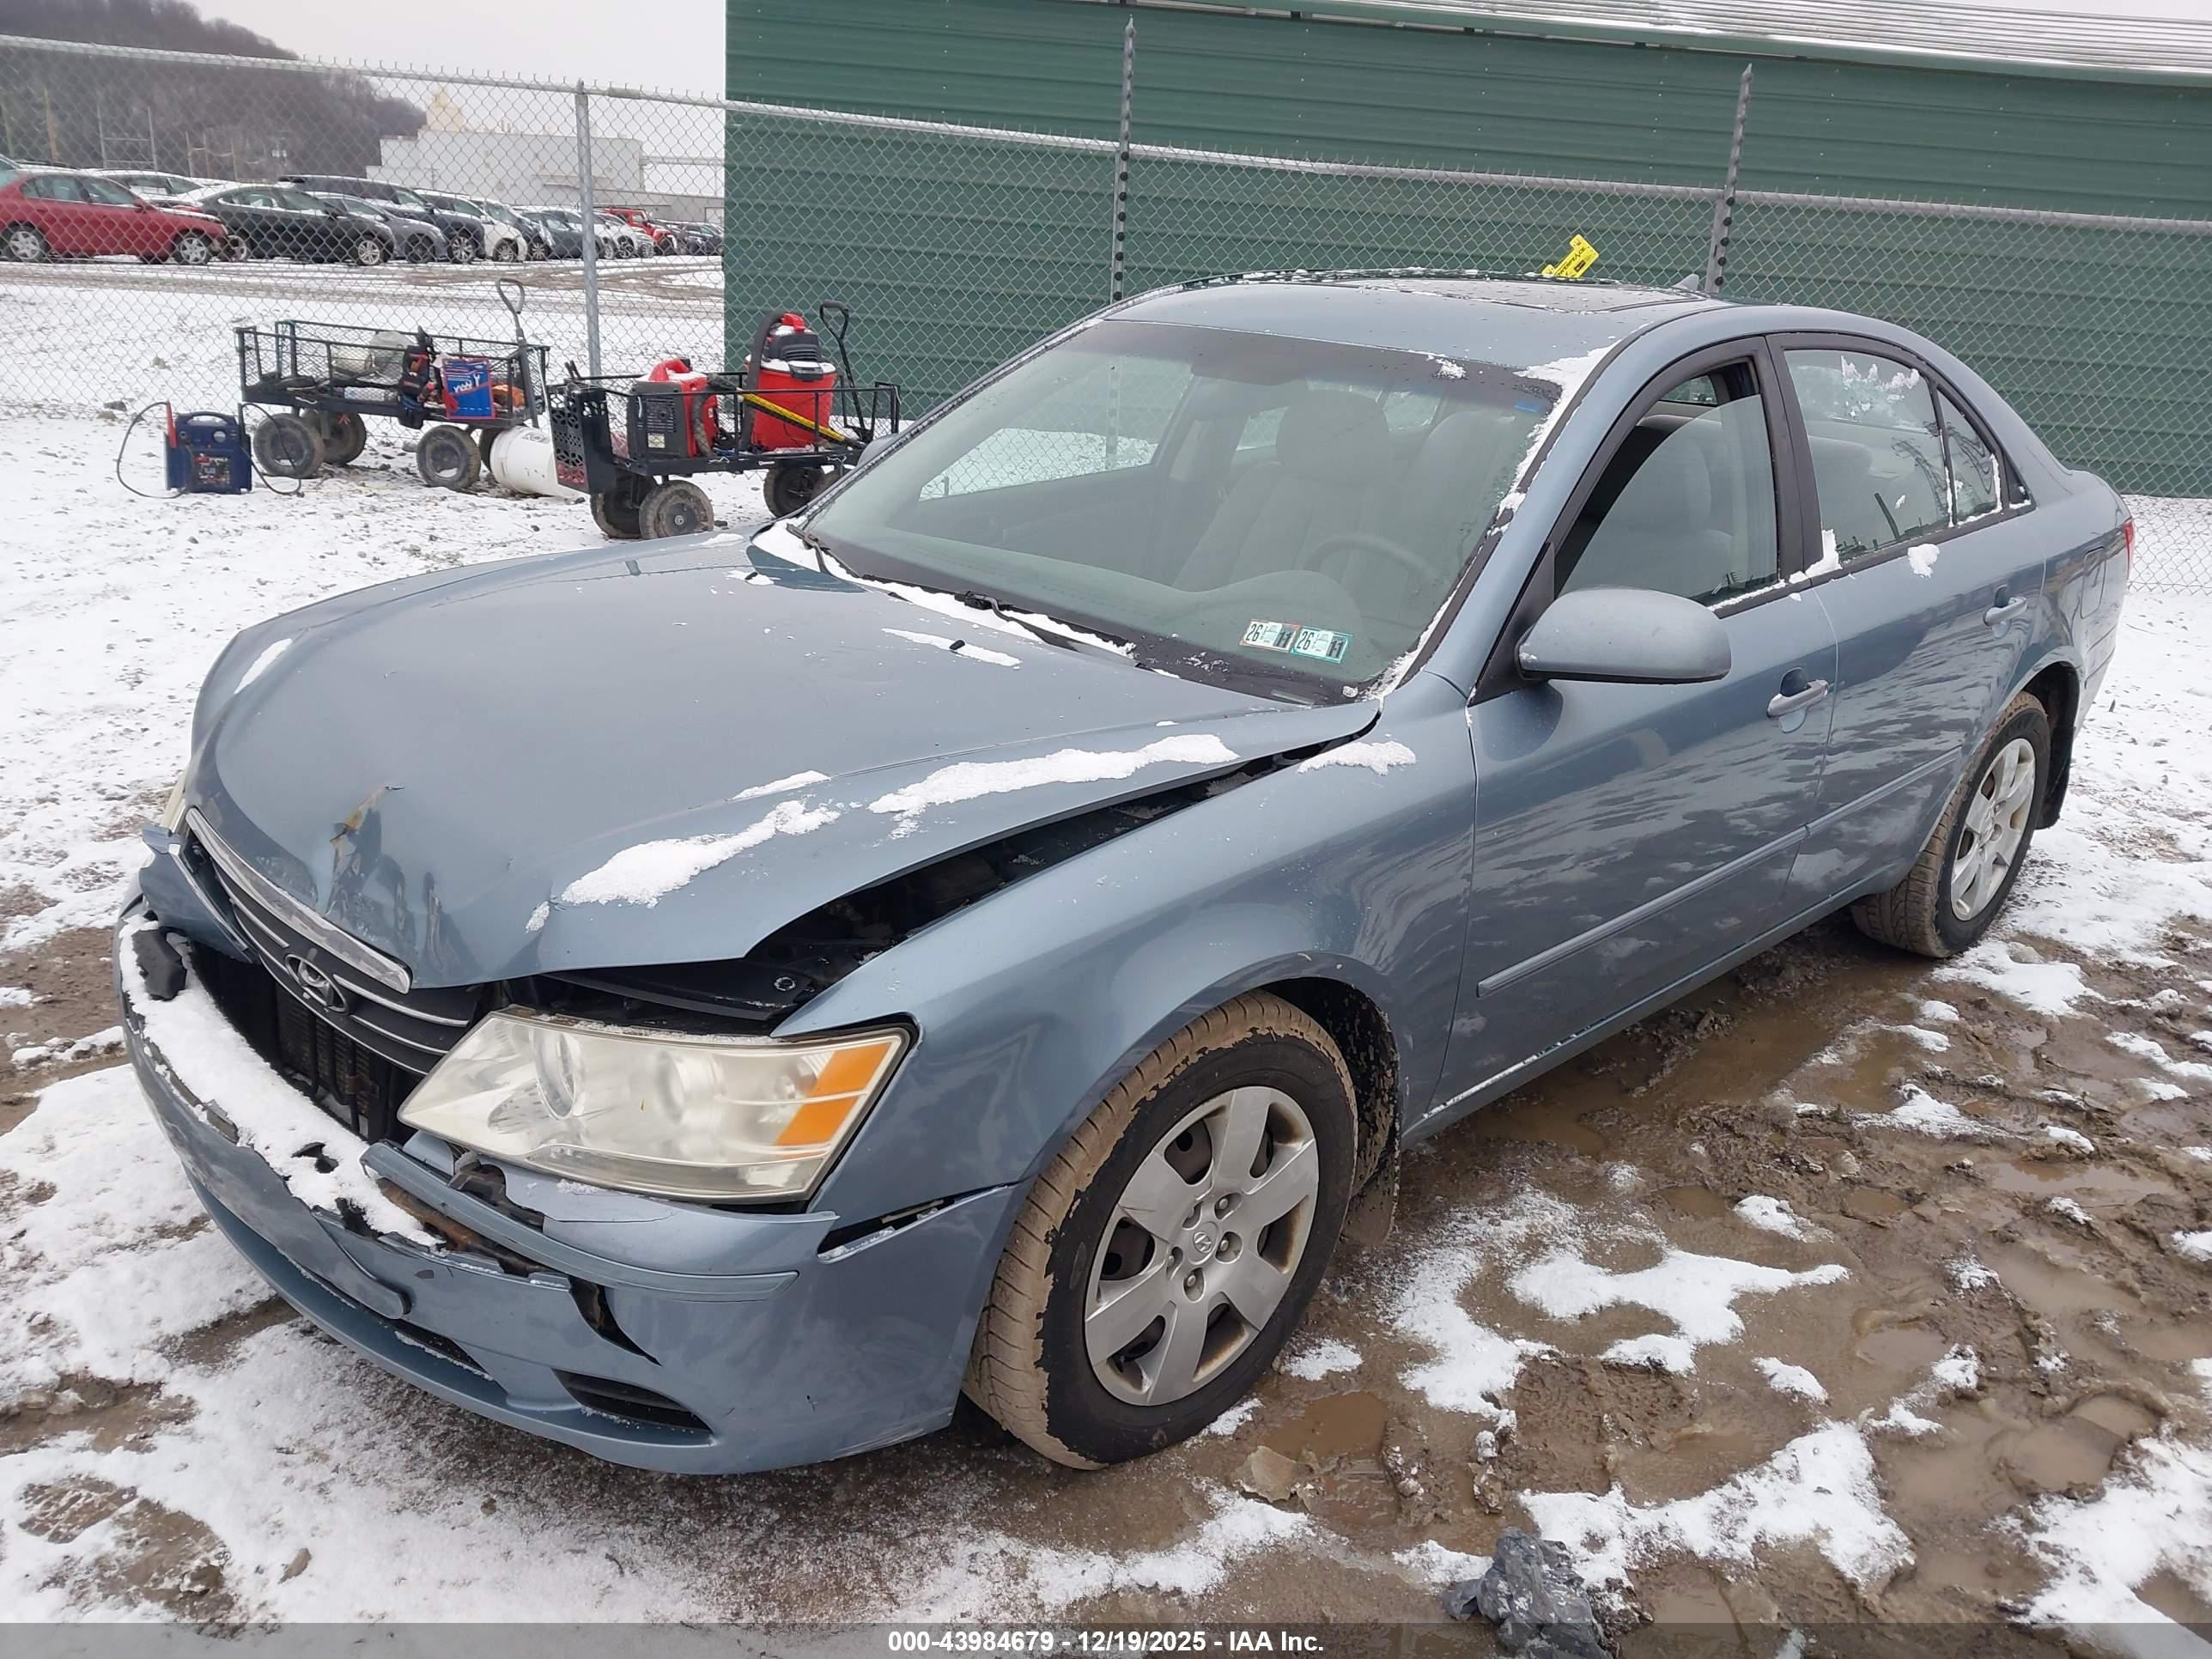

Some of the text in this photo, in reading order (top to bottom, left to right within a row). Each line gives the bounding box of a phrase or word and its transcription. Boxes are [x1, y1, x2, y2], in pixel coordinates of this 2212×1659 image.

[1246, 623, 1263, 641] 26
[1276, 631, 1292, 648] 11
[1297, 630, 1314, 650] 26
[1328, 640, 1345, 658] 11
